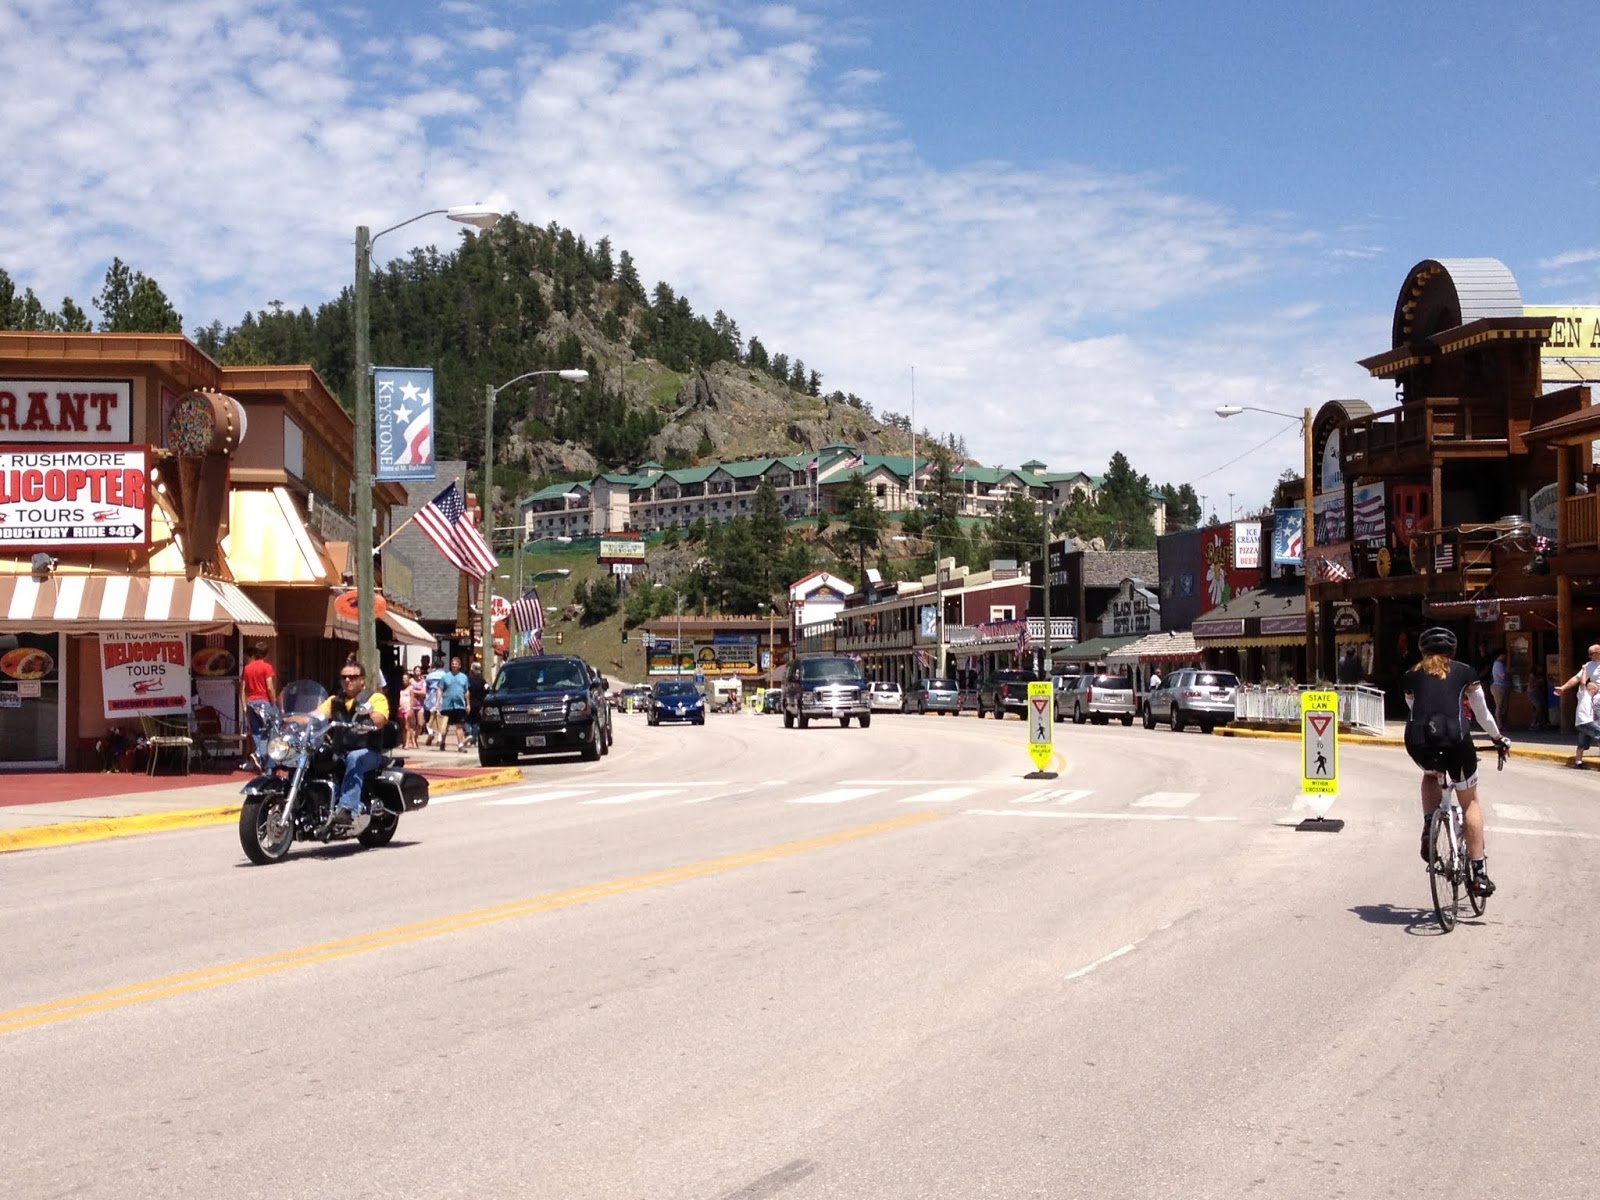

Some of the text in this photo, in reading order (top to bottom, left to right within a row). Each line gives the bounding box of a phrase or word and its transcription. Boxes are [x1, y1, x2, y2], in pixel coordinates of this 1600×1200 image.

[1541, 317, 1582, 348] EN
[379, 380, 394, 465] KEYSTONE
[12, 453, 126, 468] RUSHMORE
[15, 508, 84, 523] TOURS
[0, 526, 136, 539] DUCTORY RIDE $49
[1246, 528, 1257, 536] ICE
[1236, 536, 1261, 544] CREAM
[1239, 547, 1259, 555] PIZZA
[1240, 557, 1257, 565] BEER
[103, 641, 185, 670] HELICOPTER
[126, 664, 166, 676] TOURS
[1308, 694, 1331, 702] STATE
